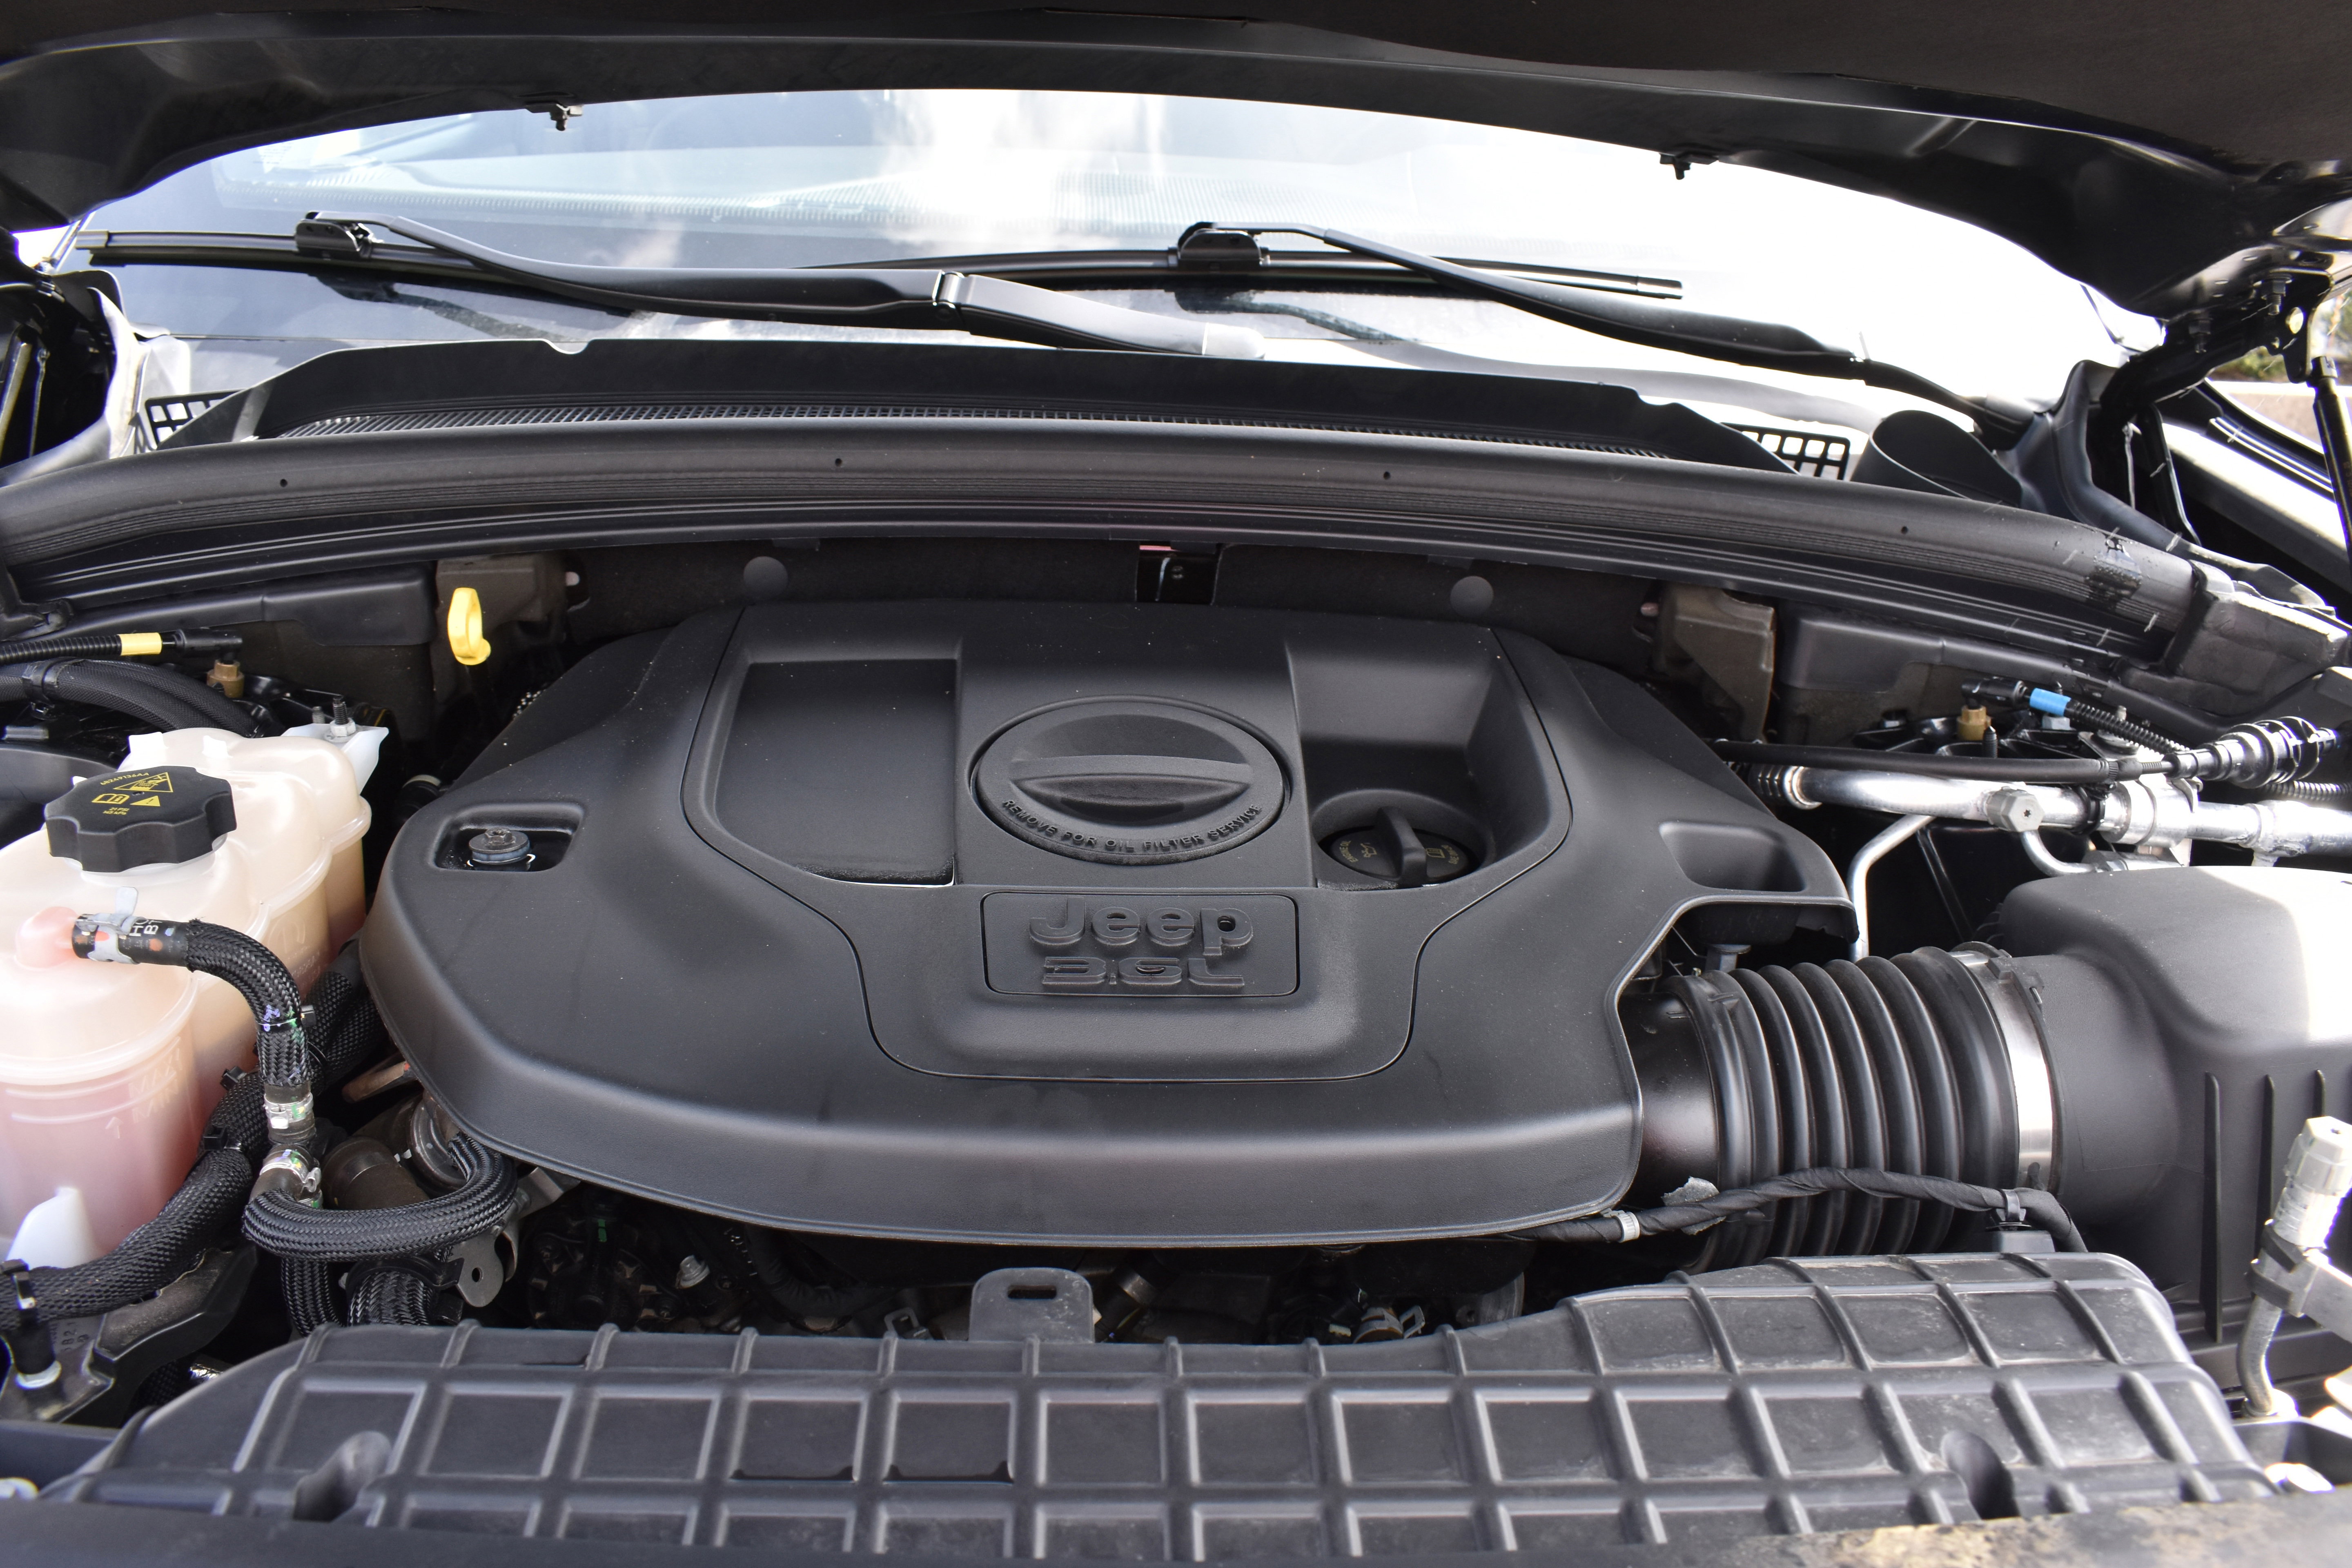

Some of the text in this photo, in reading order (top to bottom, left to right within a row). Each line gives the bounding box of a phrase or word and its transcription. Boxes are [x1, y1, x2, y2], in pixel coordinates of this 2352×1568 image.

[100, 773, 149, 785] 68249136AA
[1002, 799, 1263, 853] REMOVE FOR OIL FILTER SERVICE
[1029, 896, 1254, 956] Jeep
[1042, 956, 1245, 987] 3.6L
[127, 1054, 174, 1099] MAX
[131, 1078, 179, 1124] MIN
